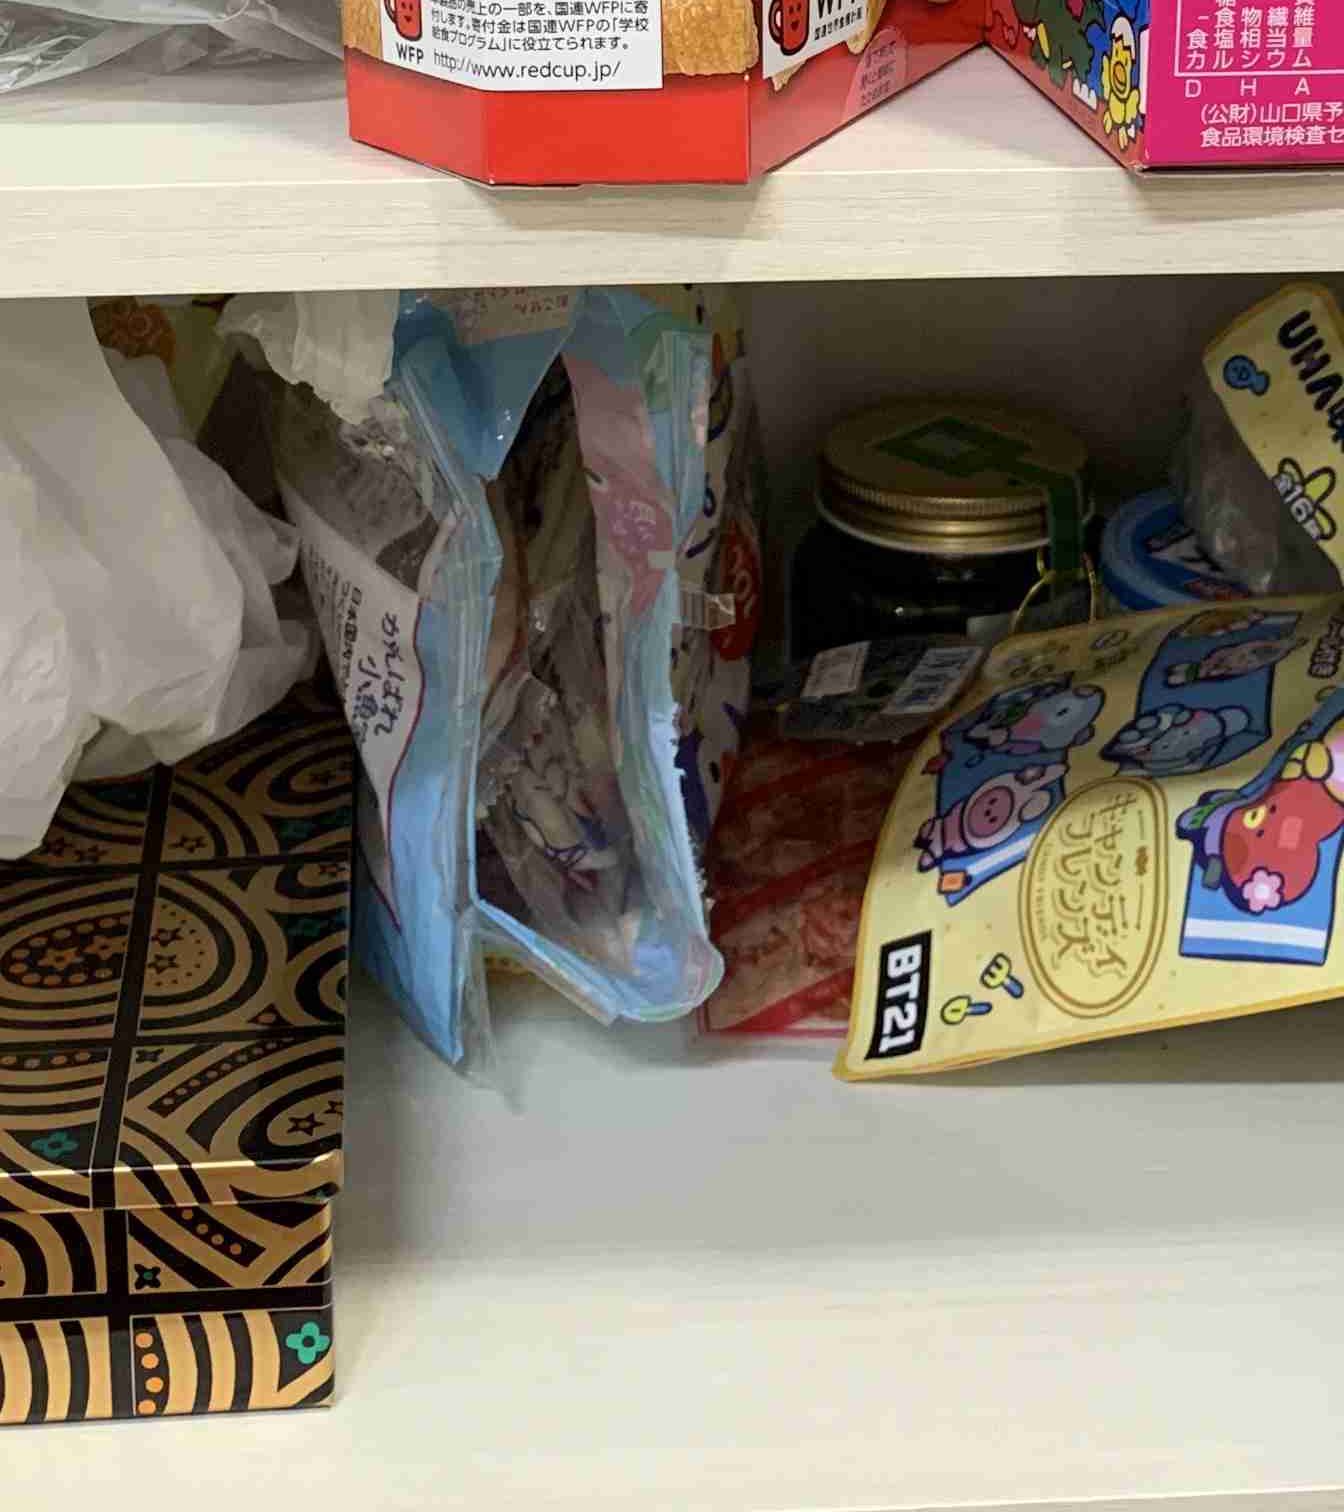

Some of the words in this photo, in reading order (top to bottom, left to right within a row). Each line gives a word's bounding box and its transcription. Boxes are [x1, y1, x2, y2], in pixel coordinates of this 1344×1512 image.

[396, 43, 424, 64] WFP
[433, 50, 620, 82] http://www.redcup.jp/
[1057, 813, 1095, 960] フレンズ
[1092, 792, 1136, 970] キャンディ
[878, 944, 922, 1052] BT21
